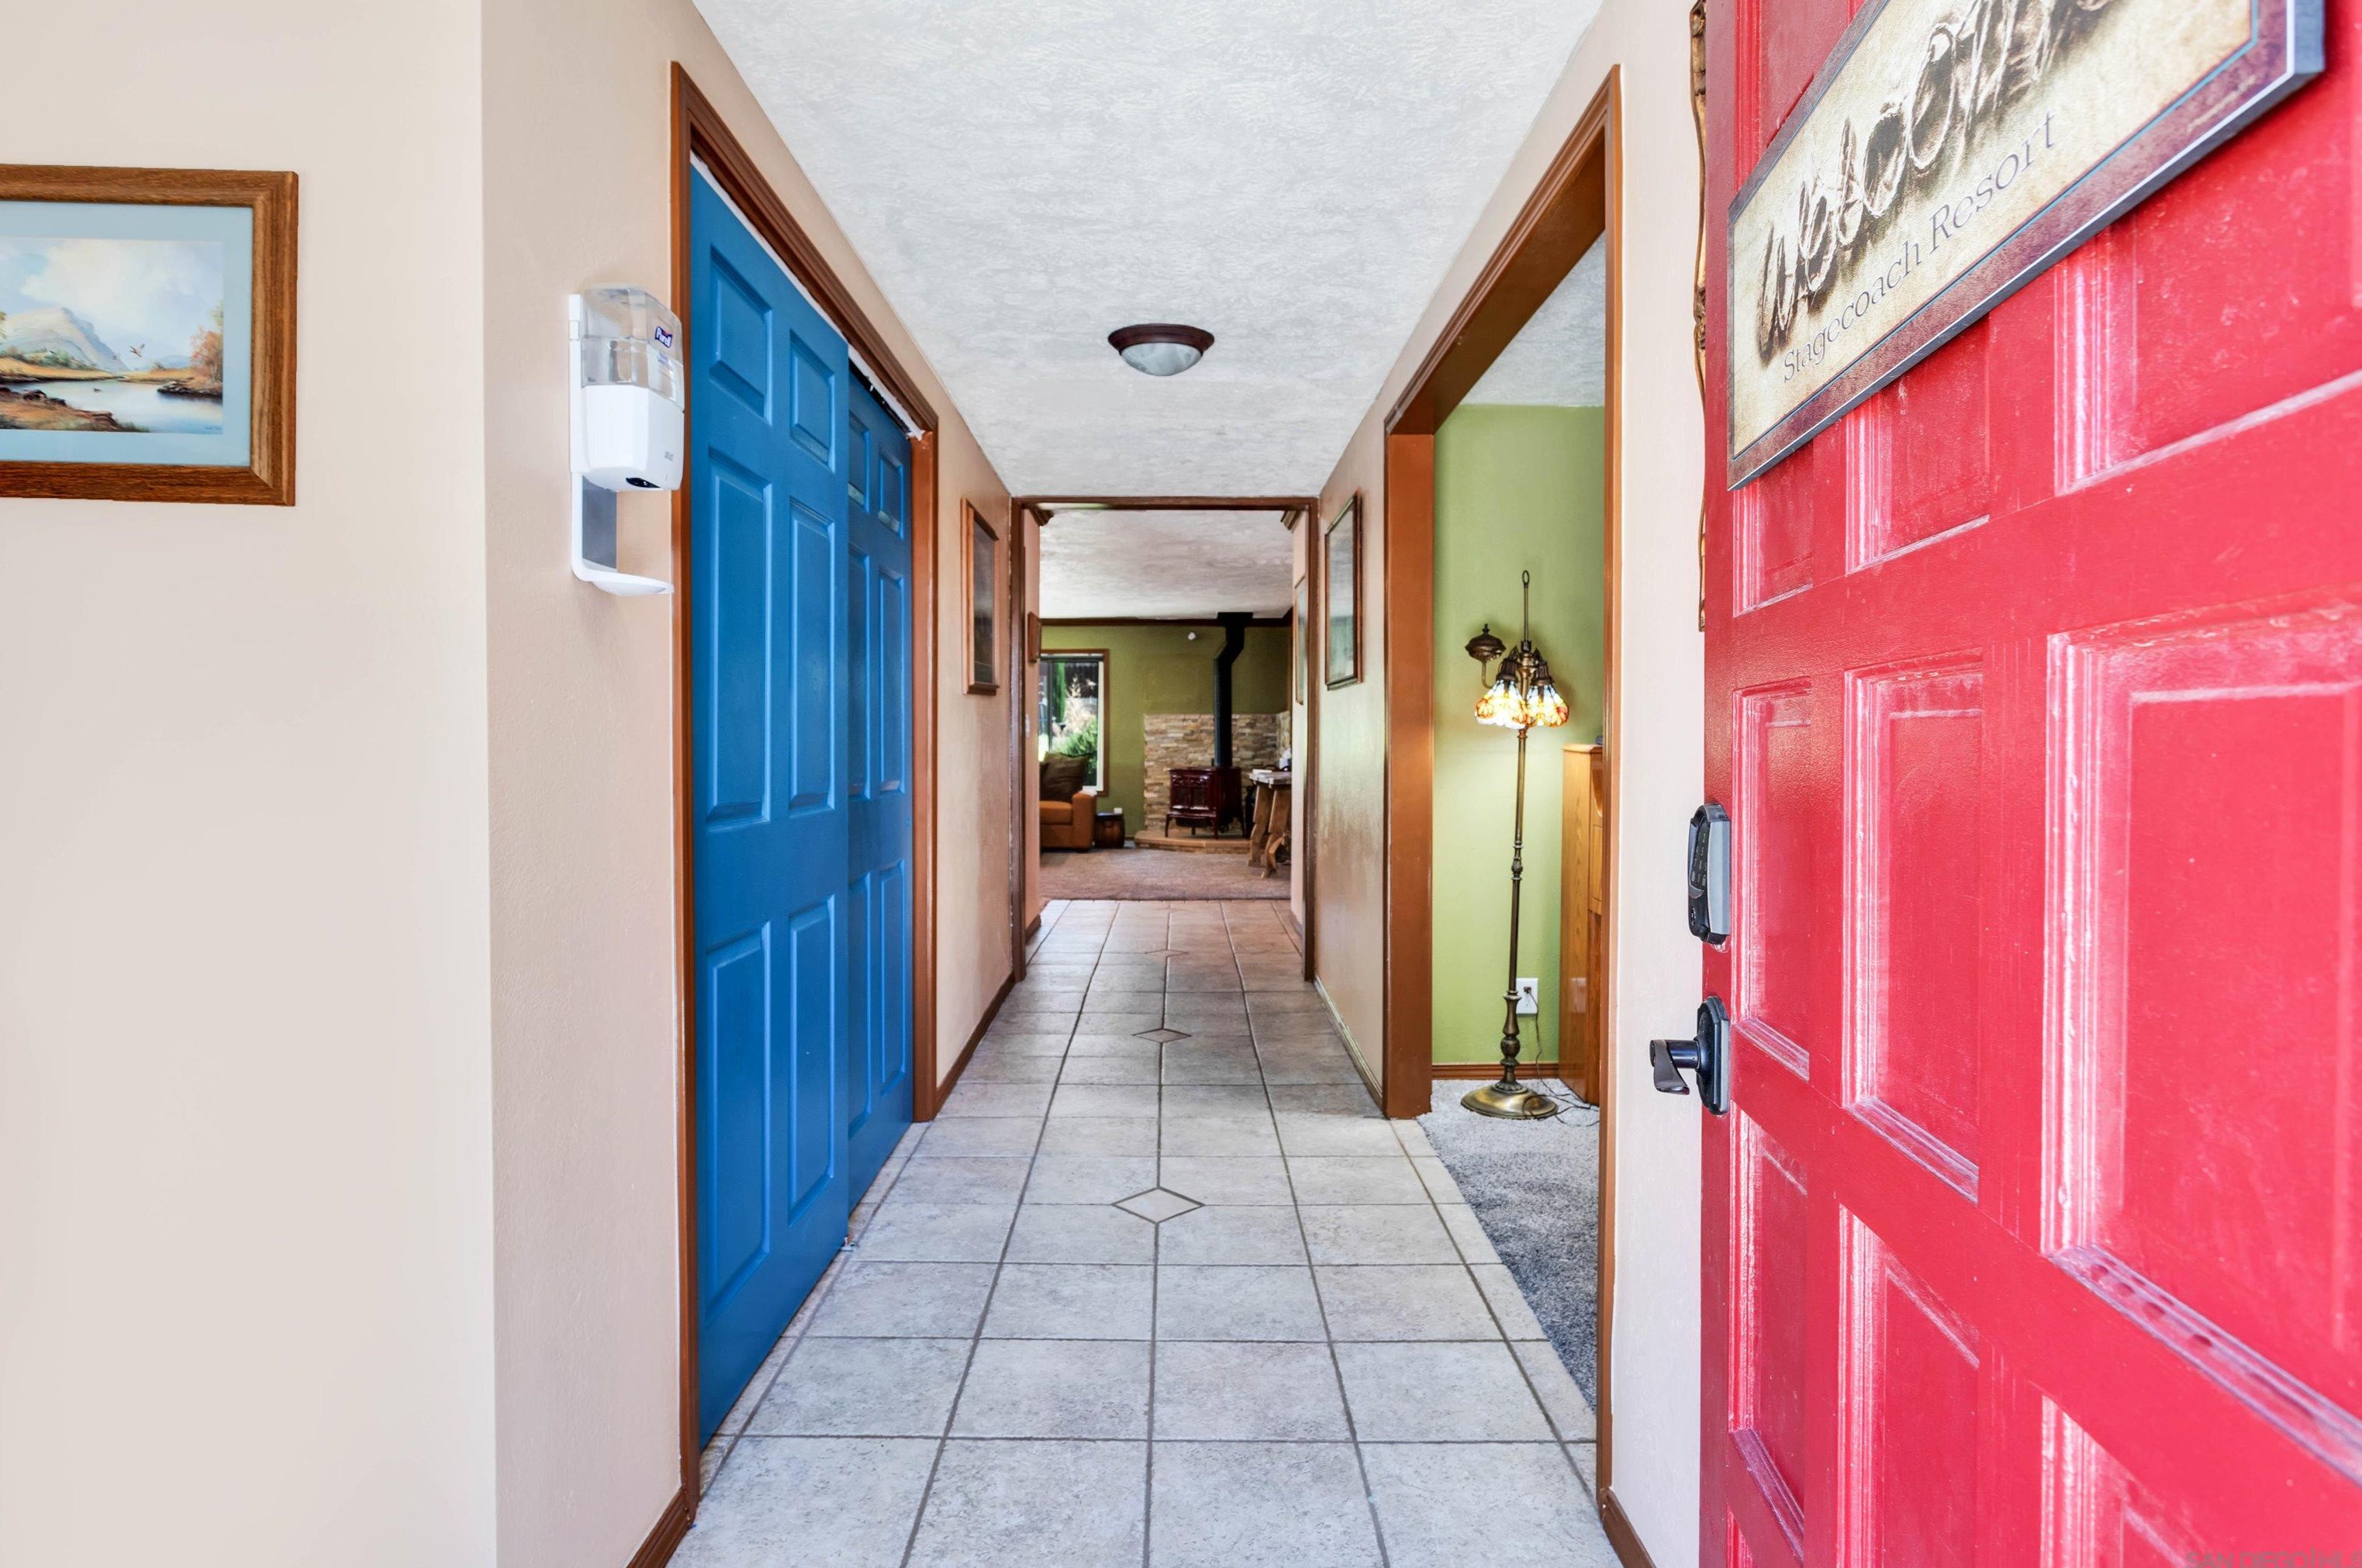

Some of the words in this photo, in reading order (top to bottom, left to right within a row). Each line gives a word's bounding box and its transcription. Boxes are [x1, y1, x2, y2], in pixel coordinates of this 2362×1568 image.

[1757, 0, 2111, 361] Welcom
[1784, 240, 1922, 383] Stagecoach
[1929, 110, 2056, 254] Resort
